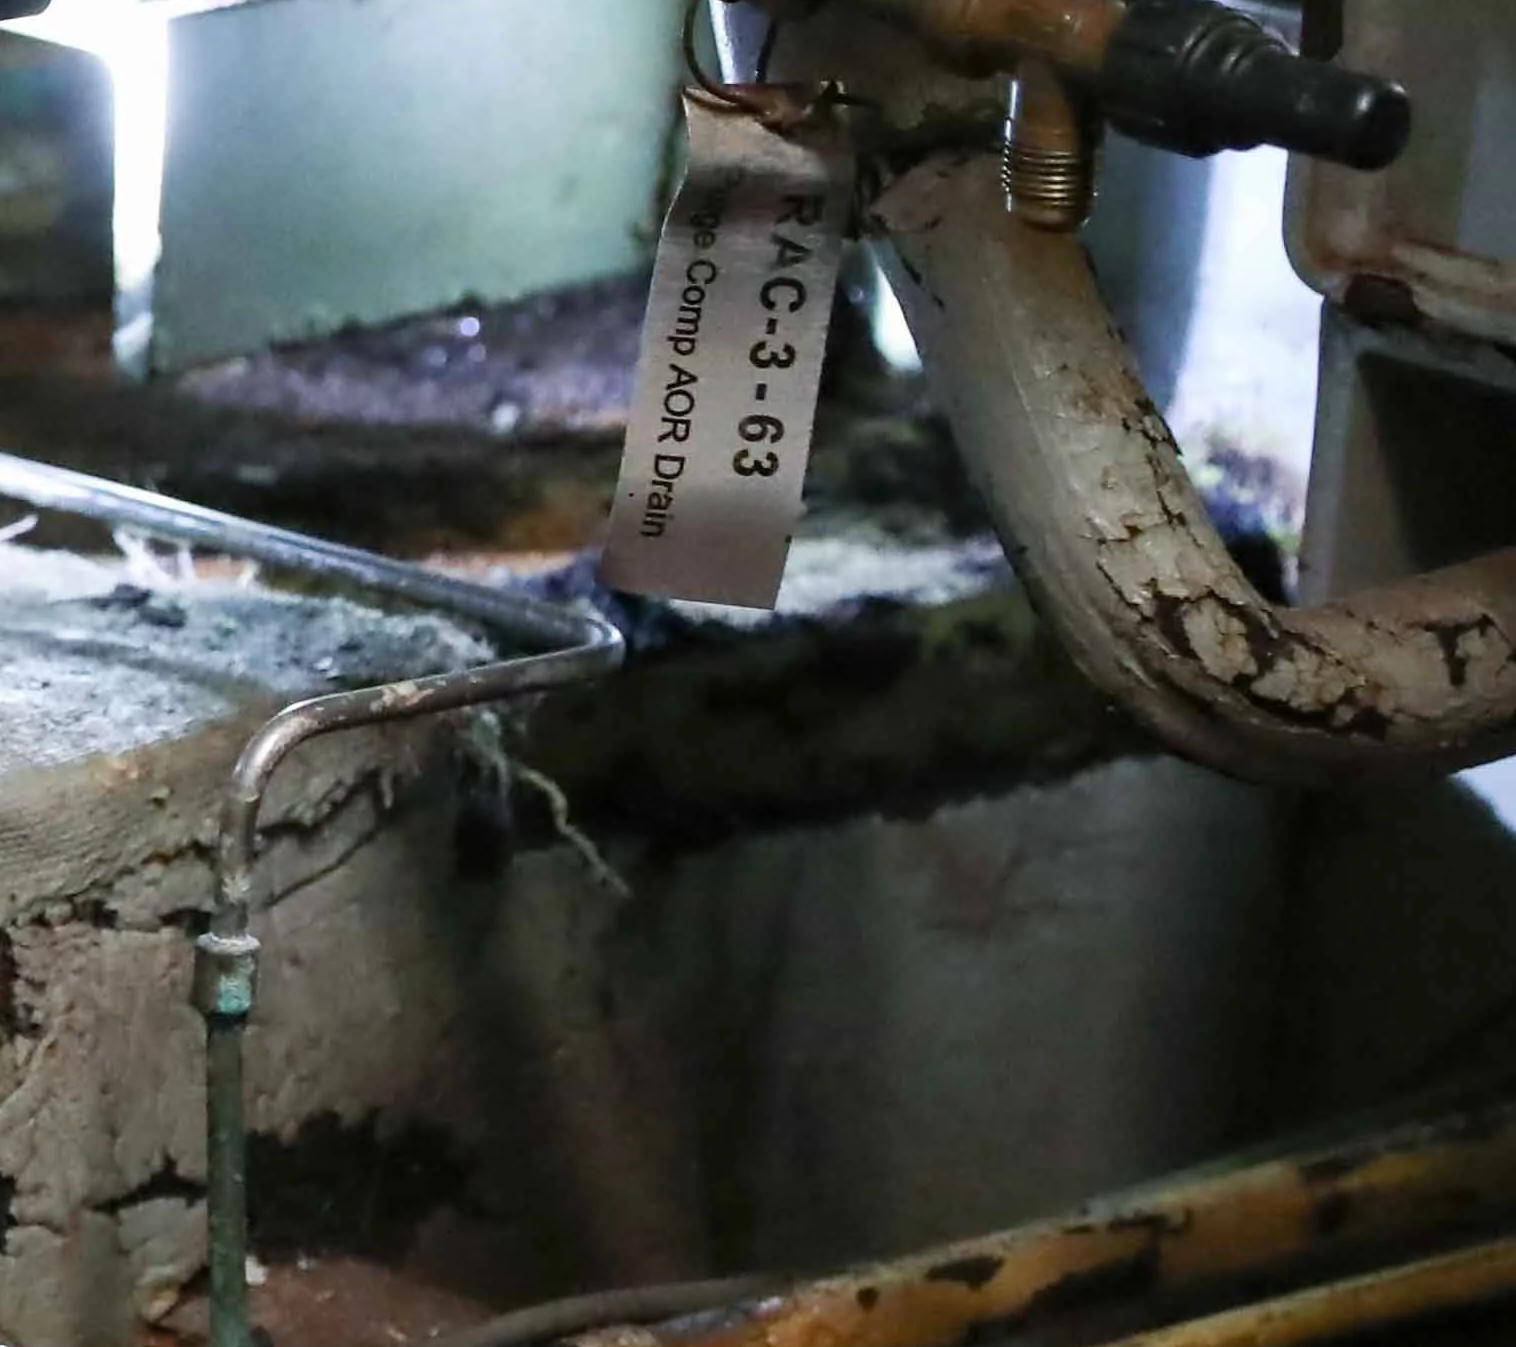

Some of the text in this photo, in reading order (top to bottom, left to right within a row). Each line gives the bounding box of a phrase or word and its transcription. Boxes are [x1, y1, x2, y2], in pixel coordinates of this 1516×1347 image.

[666, 258, 717, 357] Comp
[733, 193, 824, 478] RAC-3-63
[657, 362, 699, 443] AOR
[640, 452, 686, 539] Drain
